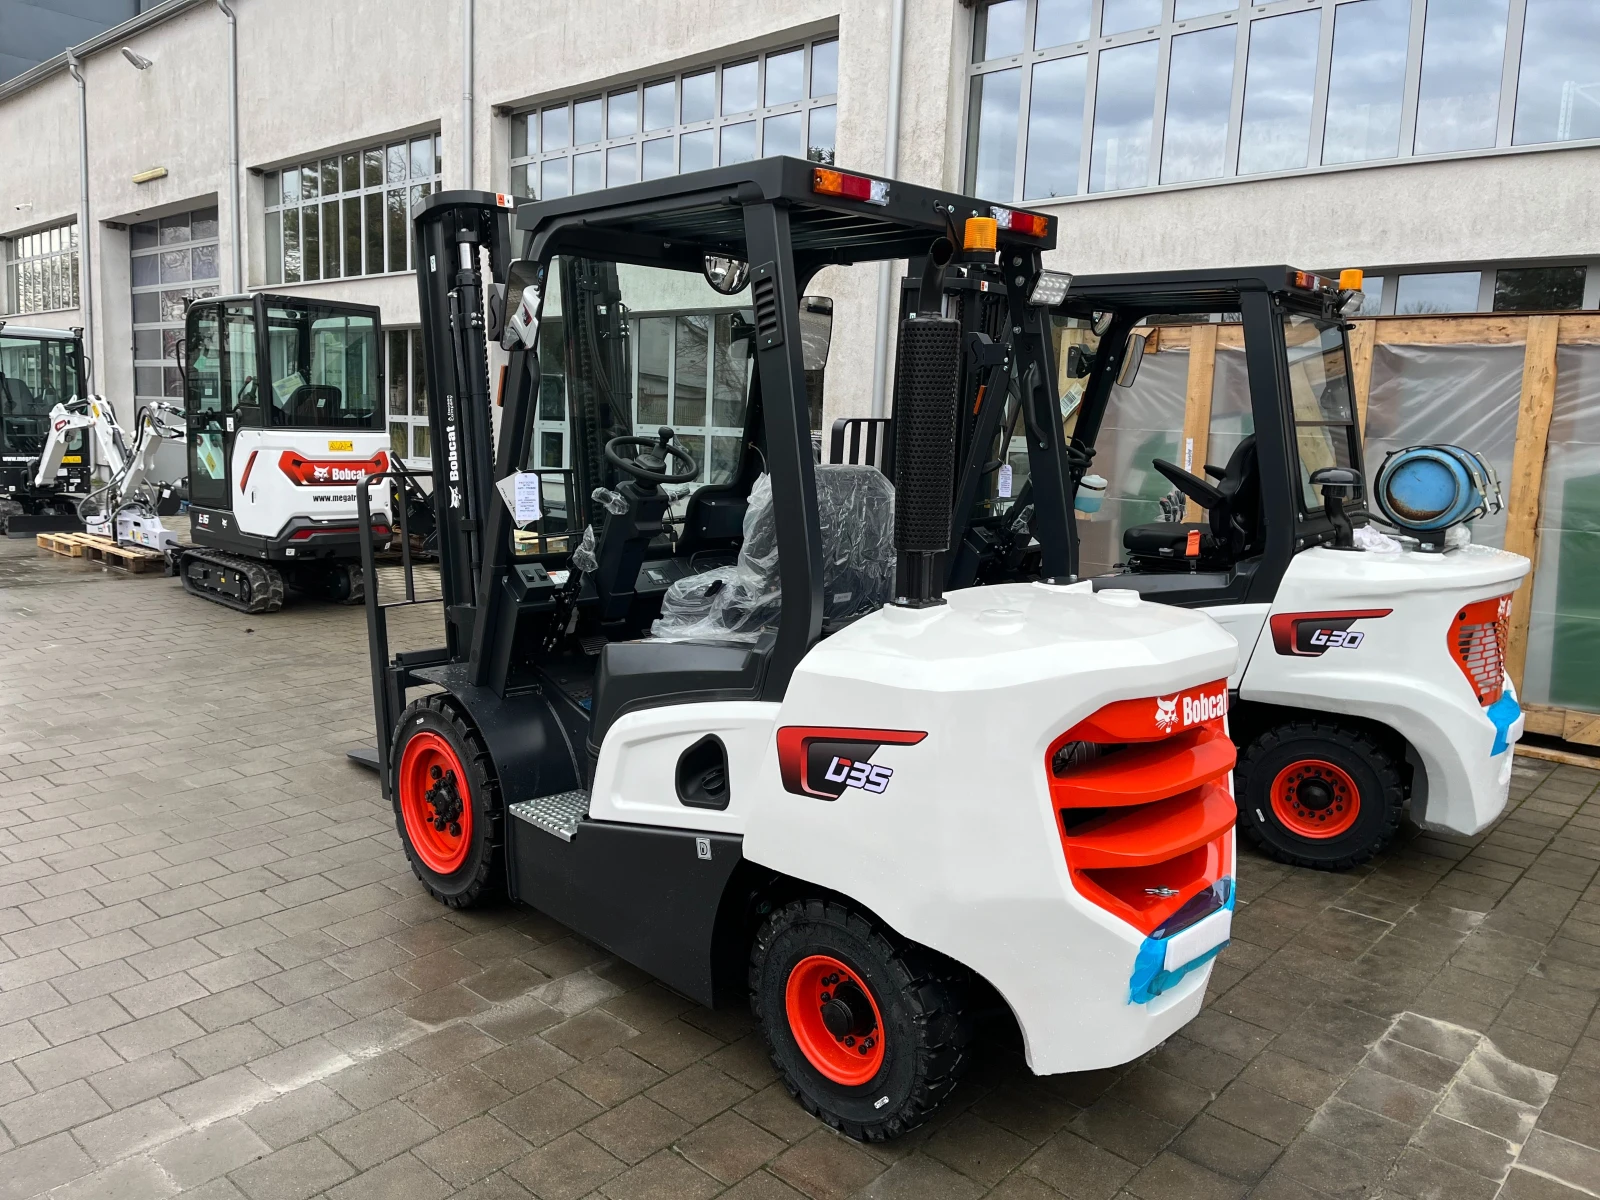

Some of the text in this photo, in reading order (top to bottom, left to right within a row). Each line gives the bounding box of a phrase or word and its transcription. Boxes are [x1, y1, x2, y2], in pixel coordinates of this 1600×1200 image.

[446, 425, 460, 481] Bobcat
[332, 468, 366, 481] Bobcat
[1310, 629, 1364, 649] G30
[1183, 688, 1227, 726] Bobcat
[824, 756, 893, 794] D35
